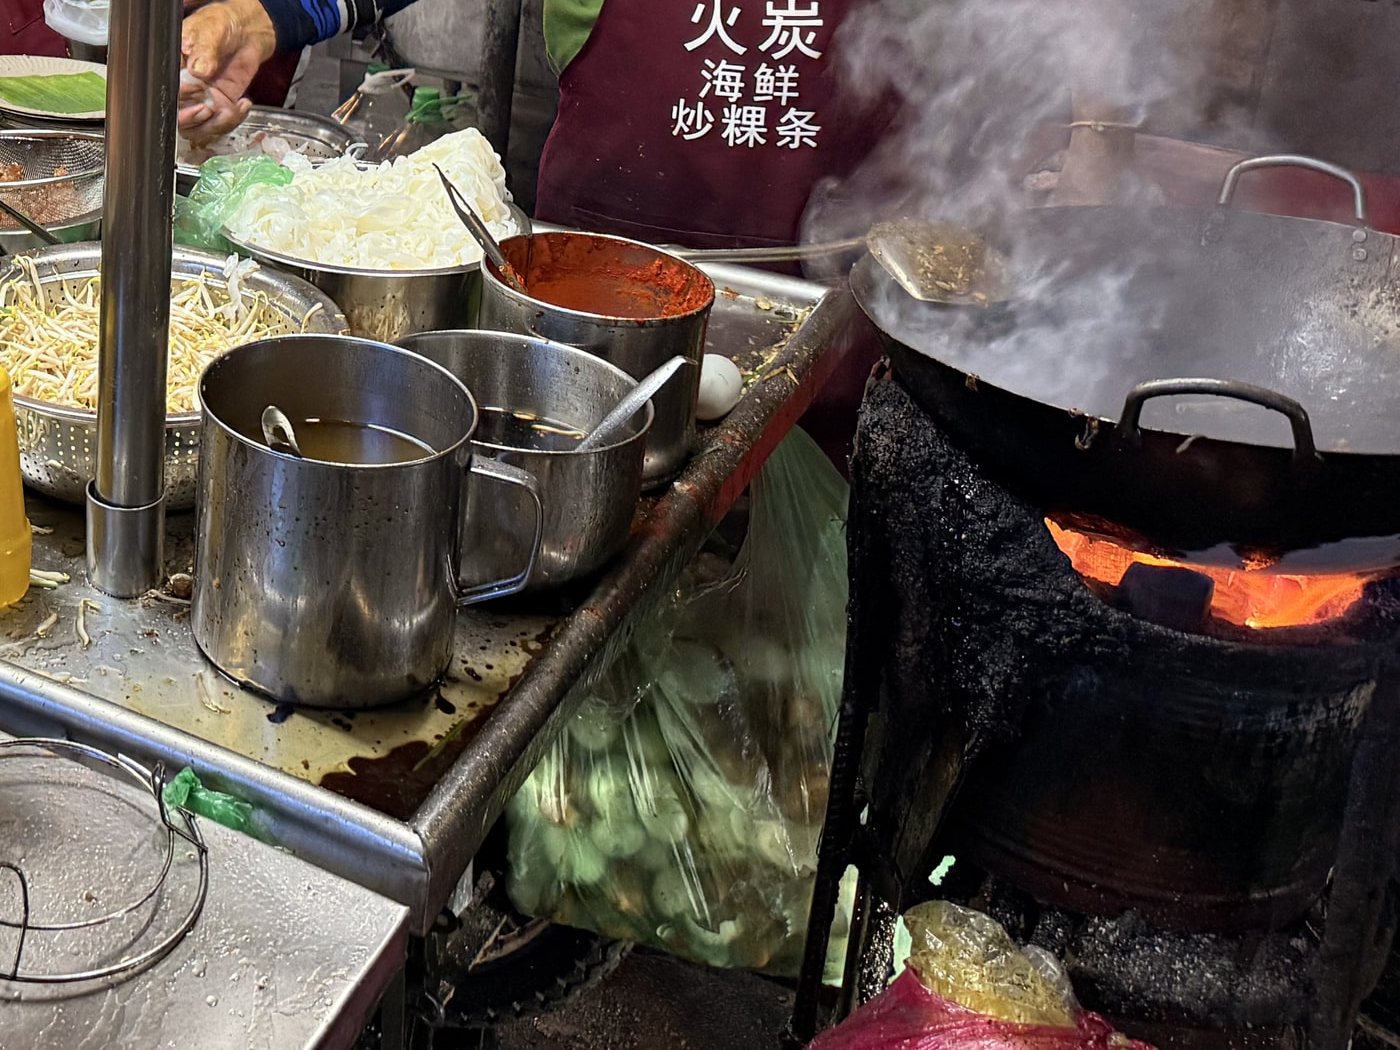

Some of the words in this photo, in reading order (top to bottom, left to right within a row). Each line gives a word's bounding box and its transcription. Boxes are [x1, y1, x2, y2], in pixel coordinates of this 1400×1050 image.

[699, 58, 799, 106] 海鲜
[671, 98, 822, 149] 炒粿条
